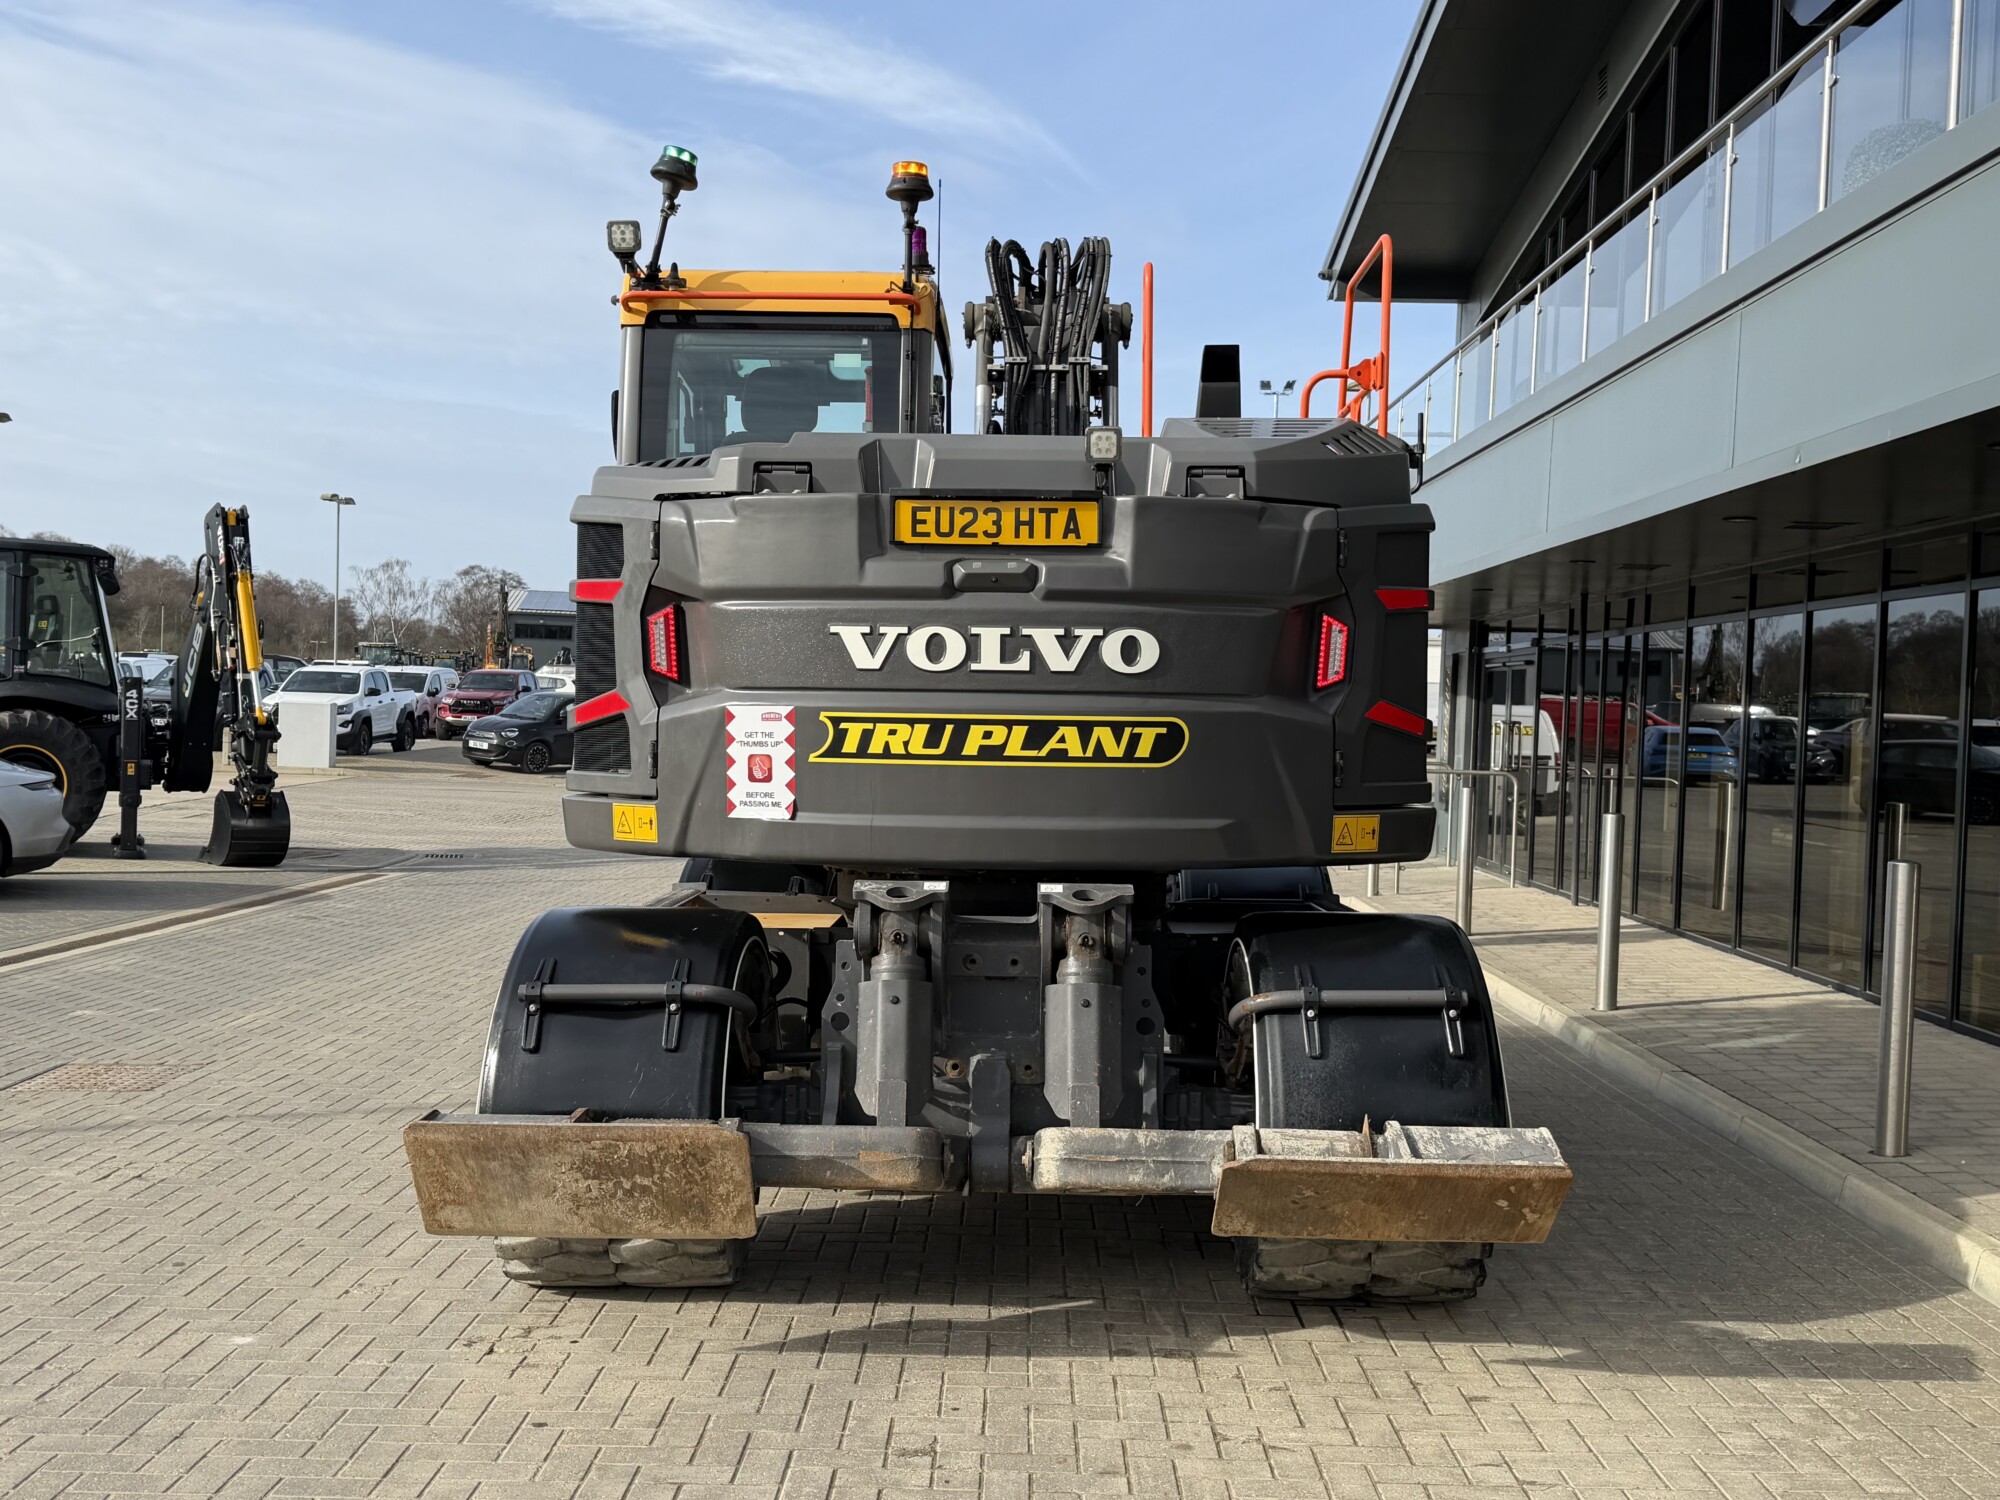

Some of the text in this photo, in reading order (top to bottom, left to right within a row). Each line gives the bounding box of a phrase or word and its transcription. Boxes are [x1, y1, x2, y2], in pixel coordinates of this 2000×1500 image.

[911, 506, 1082, 540] EU23 HTA
[183, 622, 203, 698] JCB
[829, 625, 1161, 674] VOLVO
[125, 689, 138, 719] 4CX
[736, 740, 784, 748] "THUMBS UP"
[744, 731, 775, 739] GET THE
[839, 722, 1168, 758] TRU PLANT
[739, 800, 782, 809] PASSING ME
[745, 791, 775, 799] BEFORE
